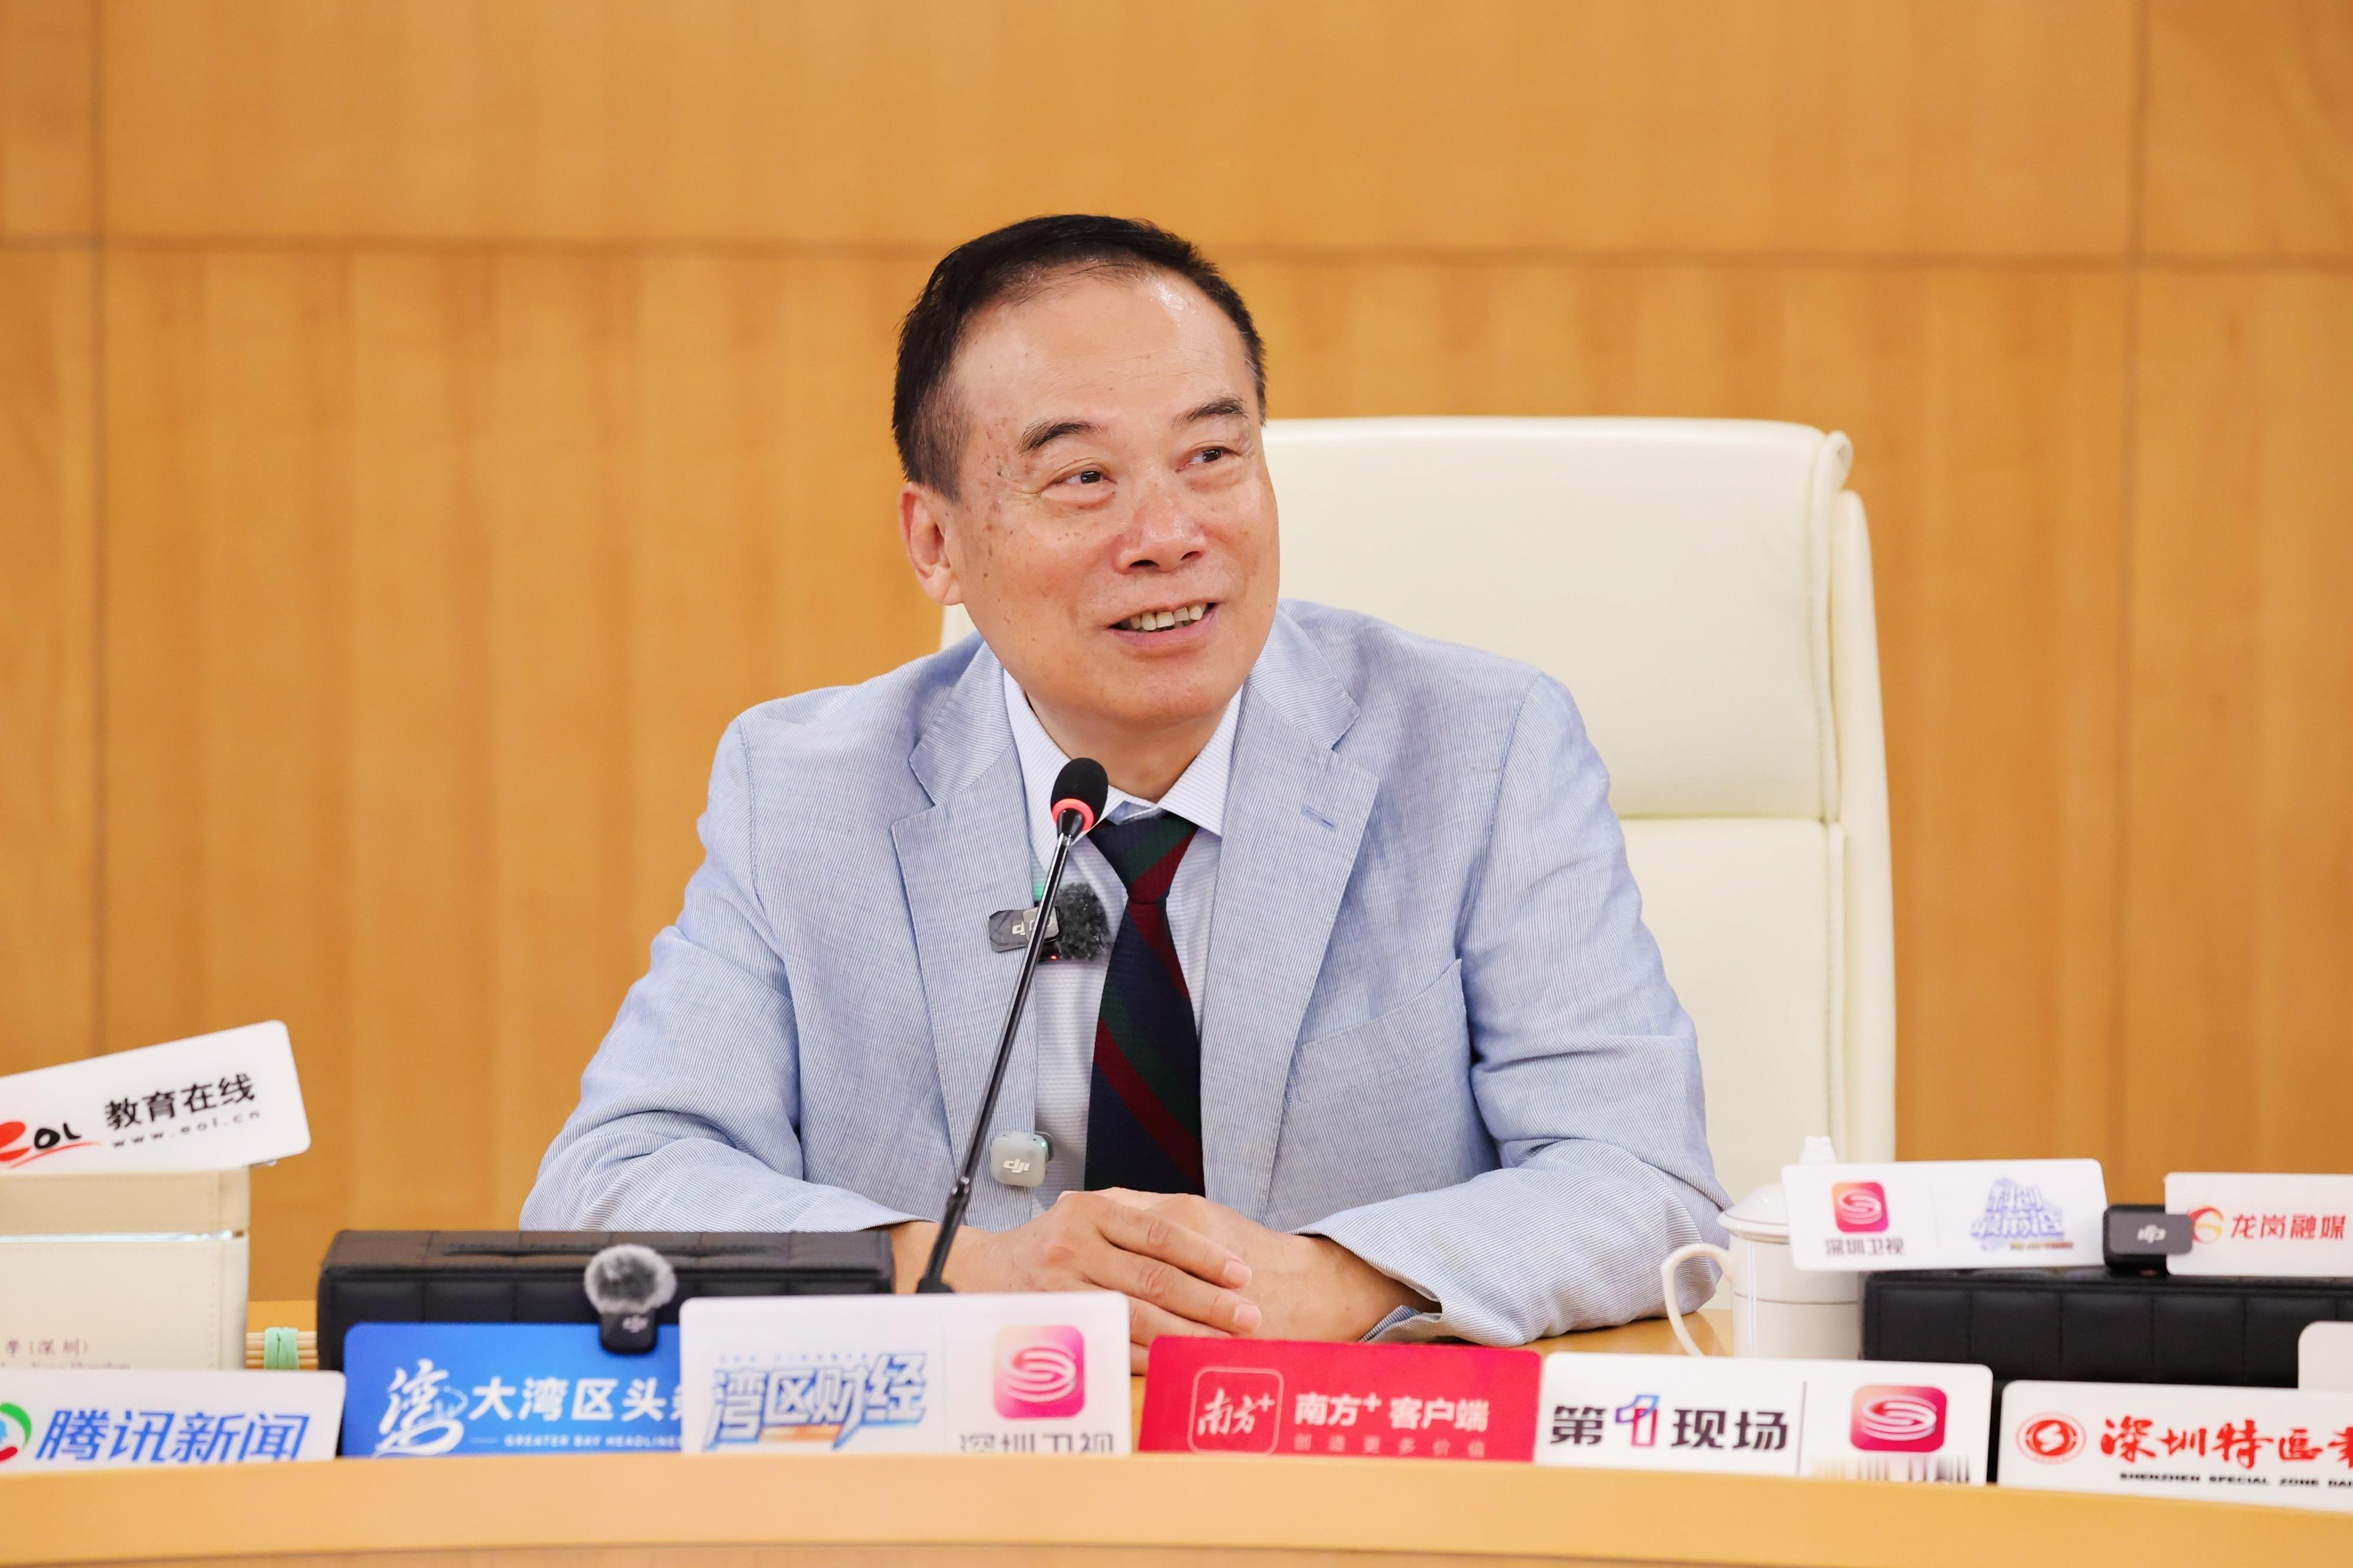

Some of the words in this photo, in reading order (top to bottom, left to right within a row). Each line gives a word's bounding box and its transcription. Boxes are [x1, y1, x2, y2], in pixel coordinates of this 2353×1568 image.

[105, 1073, 255, 1131] 教育在线
[112, 1111, 261, 1149] www.eol.cn
[2231, 1213, 2346, 1241] 龙岗融媒
[1825, 1238, 1905, 1256] 深圳卫视
[703, 1352, 928, 1452] 湾区财经
[1389, 1395, 1490, 1432] 客户端
[35, 1410, 310, 1463] 腾讯新闻
[504, 1434, 570, 1447] GREATER
[573, 1434, 601, 1447] BAY
[1549, 1394, 1788, 1452] 第1现场
[1294, 1433, 1485, 1458] 创造更多价值
[2120, 1472, 2201, 1483] SHENZHEN
[2209, 1476, 2270, 1488] SPECIAL
[2279, 1478, 2320, 1488] ZONE
